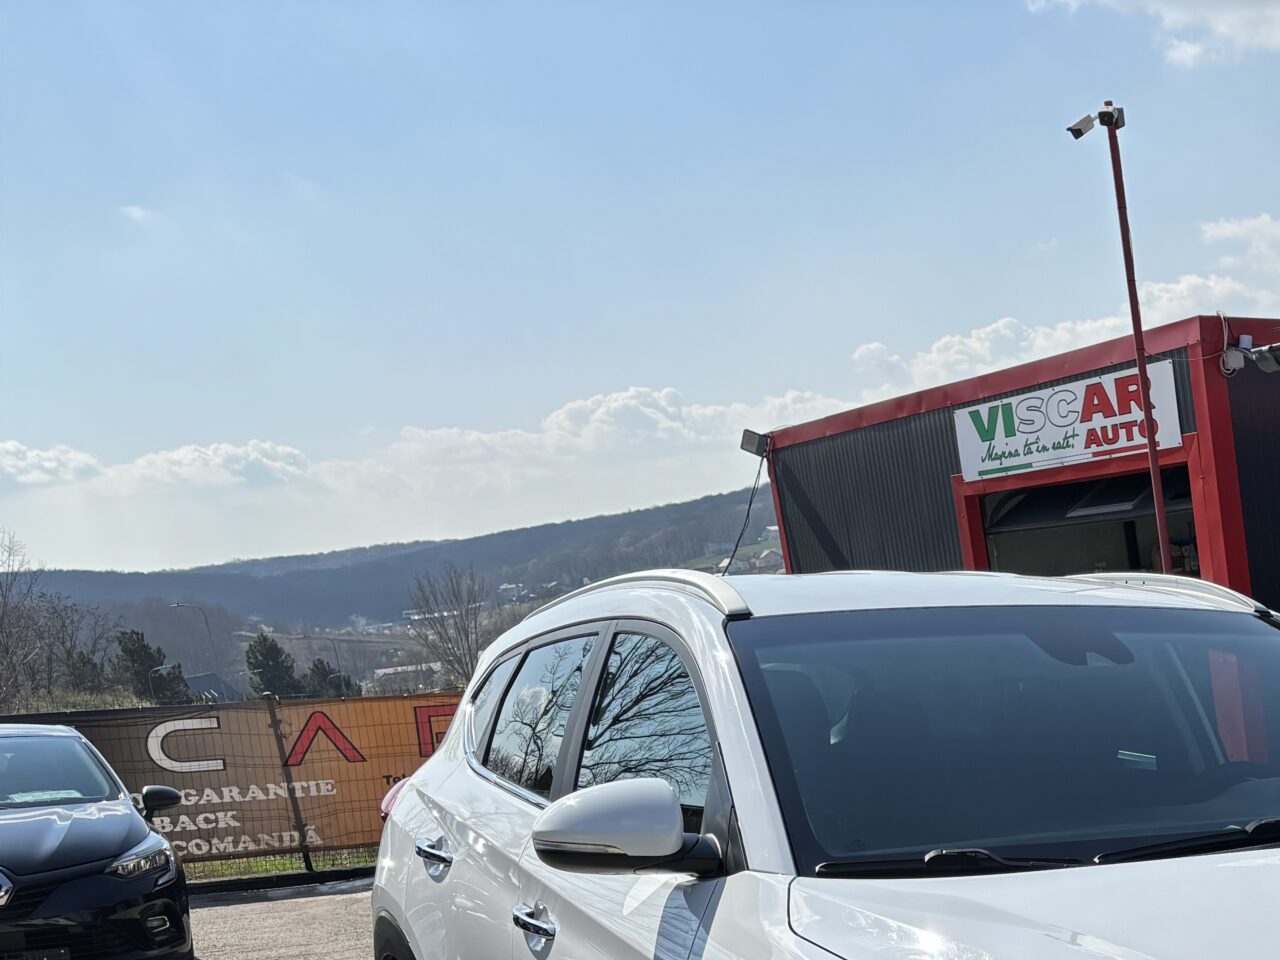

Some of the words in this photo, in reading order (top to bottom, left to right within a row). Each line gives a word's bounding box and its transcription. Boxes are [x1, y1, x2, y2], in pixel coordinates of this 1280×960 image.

[968, 373, 1157, 443] VISCAR
[1084, 417, 1159, 450] AUTO
[179, 779, 337, 806] GARANTIE
[151, 810, 241, 834] BACK
